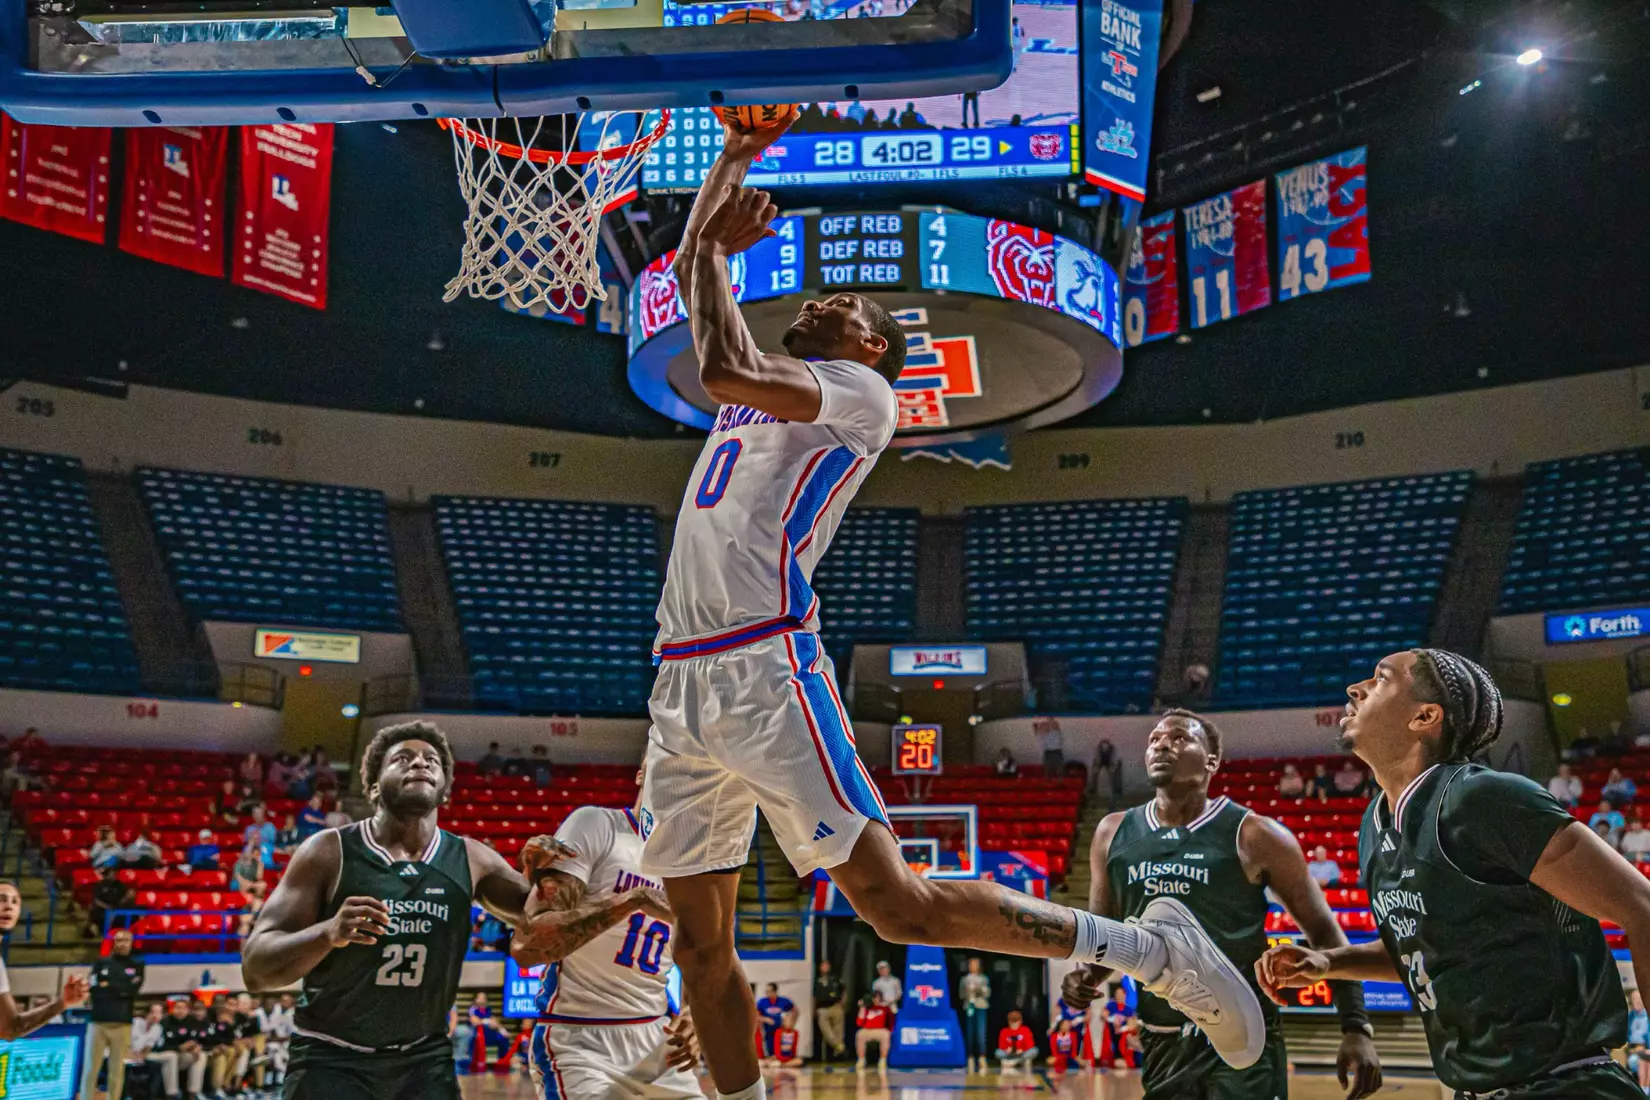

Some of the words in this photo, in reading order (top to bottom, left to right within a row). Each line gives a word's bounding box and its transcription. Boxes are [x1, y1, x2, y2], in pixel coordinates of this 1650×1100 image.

[1101, 11, 1141, 50] BANK
[815, 140, 854, 166] 28
[872, 140, 933, 164] 4:02
[951, 136, 991, 161] 29
[849, 171, 876, 182] LAST
[1278, 161, 1328, 202] VENUS
[778, 219, 795, 241] 4
[819, 216, 857, 236] OFF
[860, 214, 901, 234] REB
[928, 215, 947, 237] 4
[780, 244, 797, 265] 9
[819, 240, 859, 260] DEF
[862, 239, 903, 258] REB
[928, 239, 946, 260] 7
[770, 268, 796, 292] 13
[820, 264, 857, 284] TOT
[859, 263, 901, 283] REB
[929, 264, 949, 285] 11
[1281, 238, 1328, 297] 43
[1193, 270, 1231, 328] 11
[695, 438, 743, 509] 0
[1589, 614, 1640, 634] Forth
[126, 703, 158, 719] 104
[905, 729, 937, 745] 4:02
[901, 744, 932, 769] 20
[1127, 861, 1209, 886] Missouri
[1144, 877, 1191, 896] State
[1371, 889, 1428, 926] Missouri
[384, 916, 433, 937] State
[1388, 914, 1417, 942] State
[613, 908, 671, 976] 10
[375, 943, 428, 988] 23
